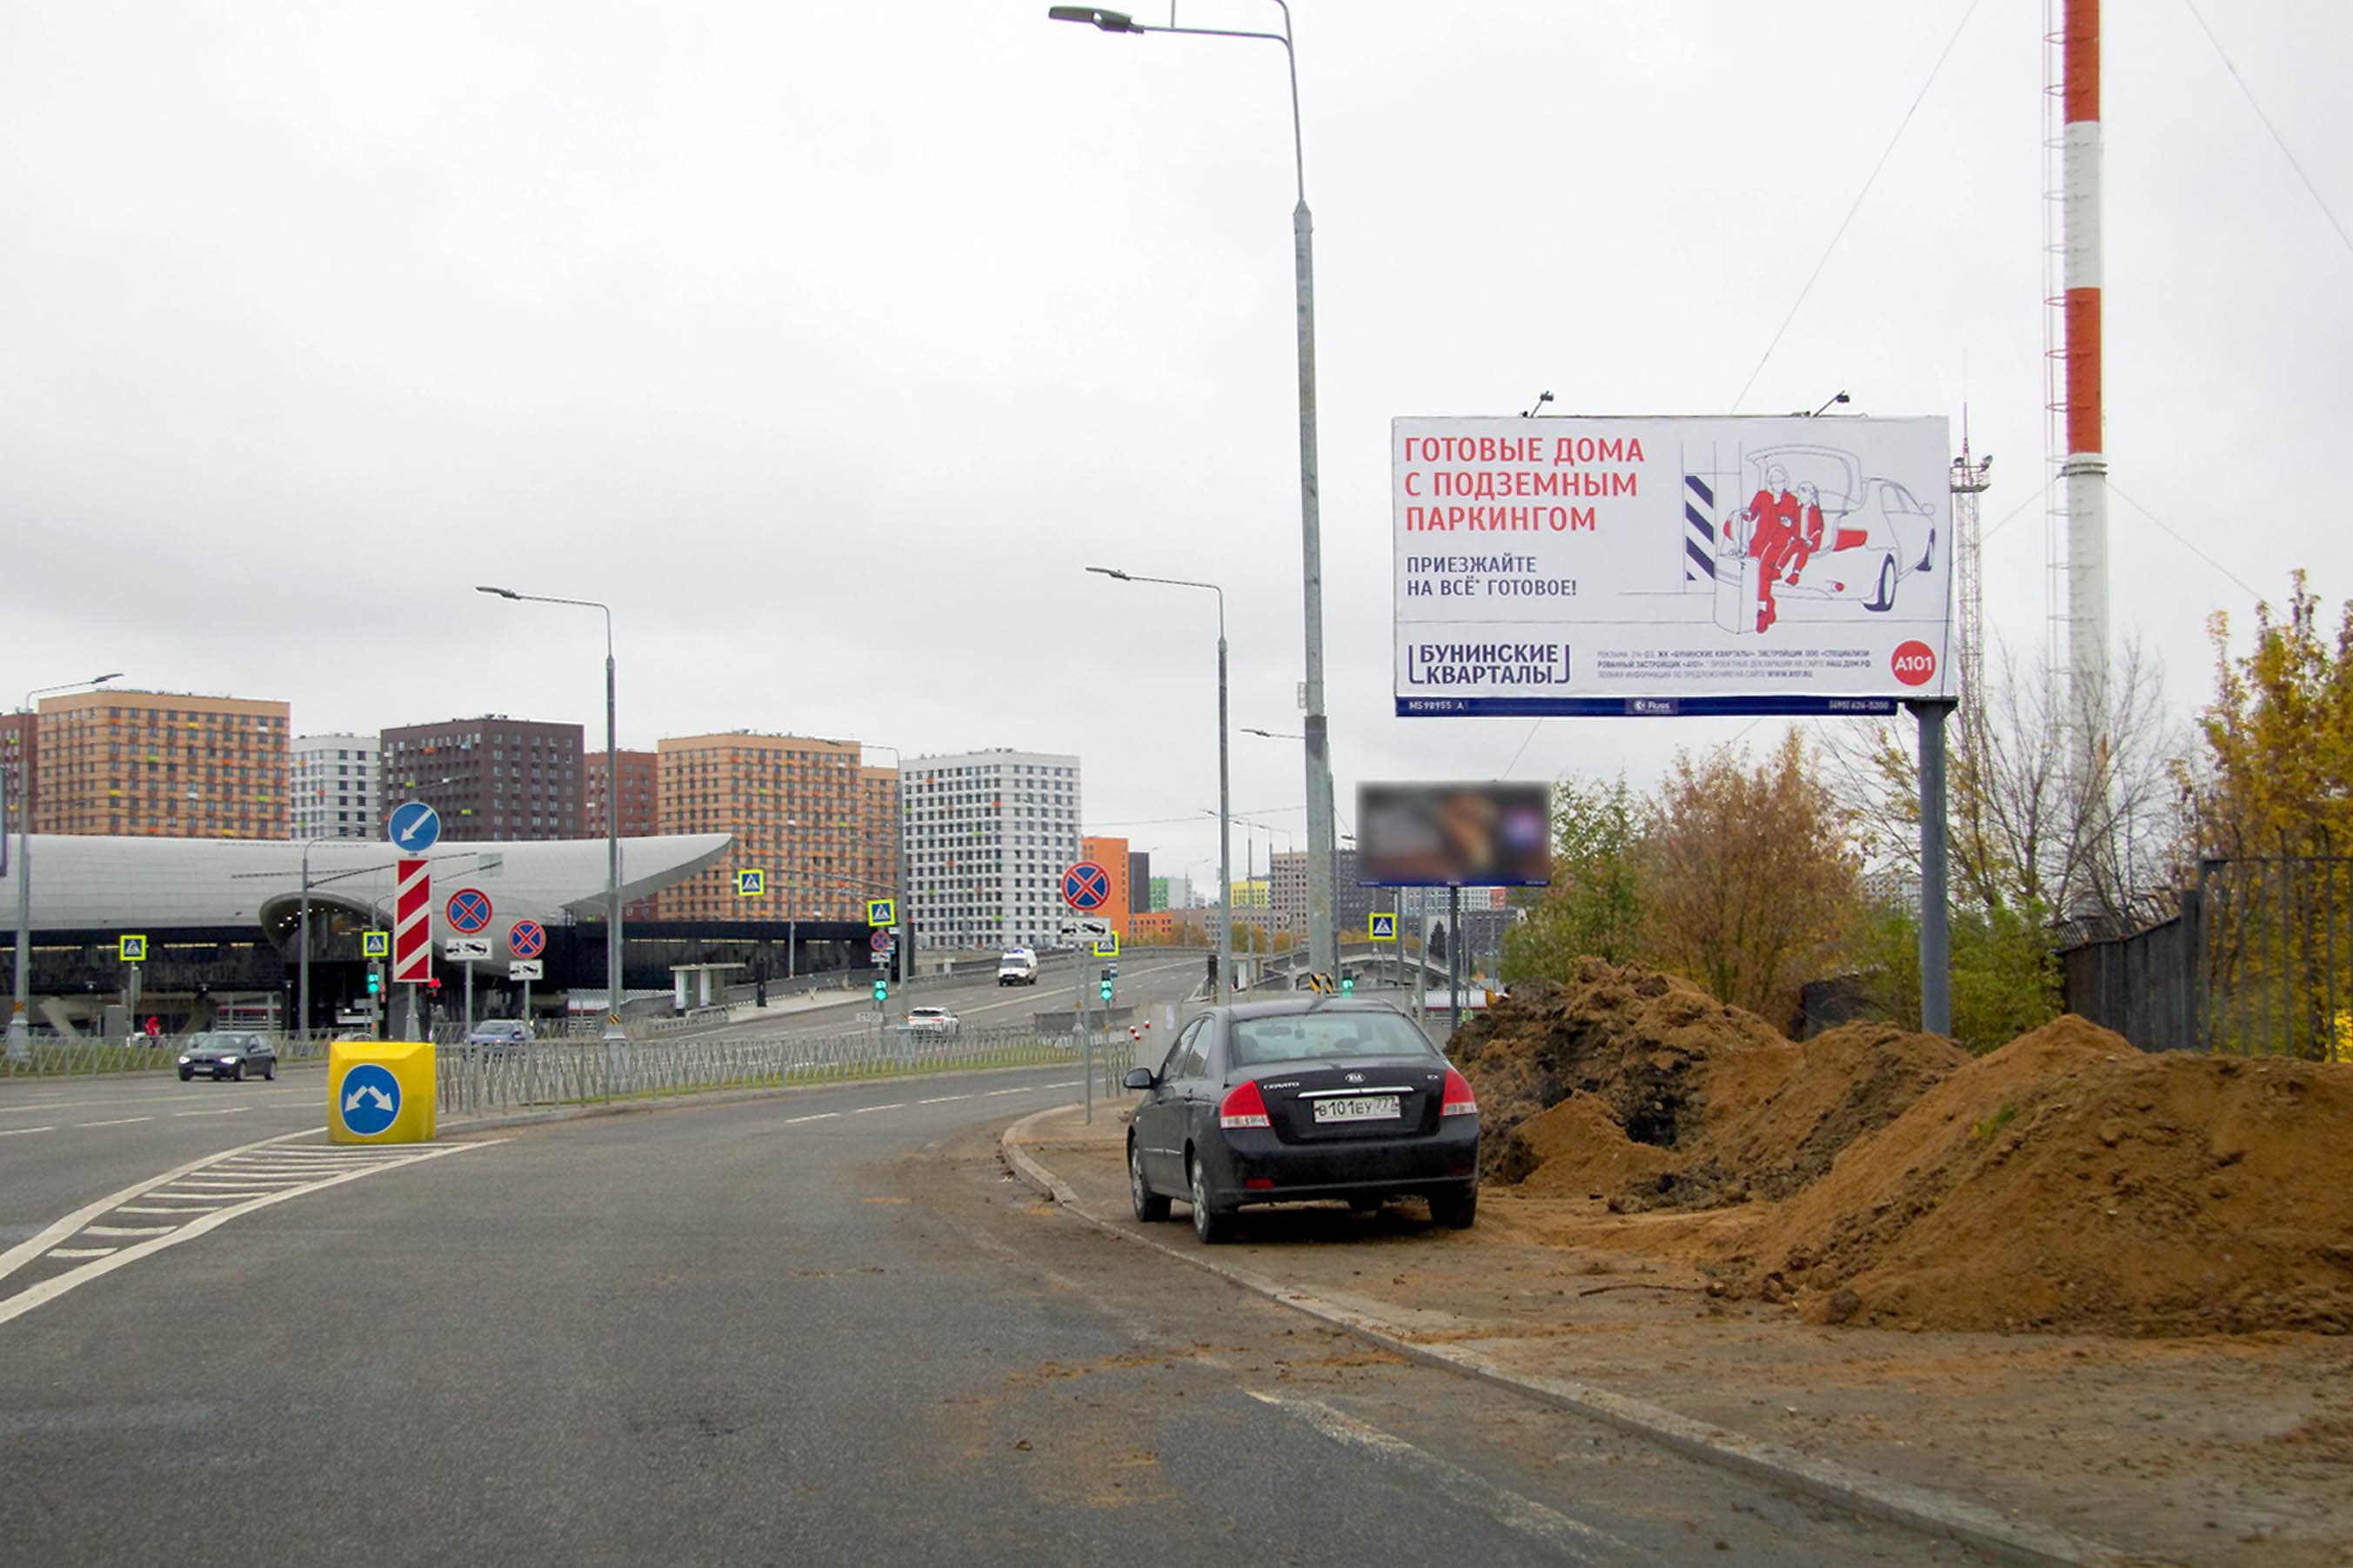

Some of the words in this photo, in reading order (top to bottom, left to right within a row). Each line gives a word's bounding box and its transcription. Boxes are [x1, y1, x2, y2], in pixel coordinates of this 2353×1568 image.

[1405, 437, 1543, 462] ГОТОВЫЕ
[1554, 437, 1645, 466] ДОМА
[1405, 472, 1420, 497] С
[1434, 472, 1637, 501] ПОДЗЕМНЫМ
[1406, 507, 1596, 530] ПАРКИНГОМ
[1407, 552, 1537, 573] ПРИЕЗЖАЙТЕ
[1407, 580, 1433, 596] НА
[1487, 579, 1577, 596] ГОТОВОЕ!
[1420, 644, 1558, 664] БУНИНСКИЕ
[1895, 656, 1932, 671] A101
[1426, 665, 1553, 684] КВАРТАЛЫ
